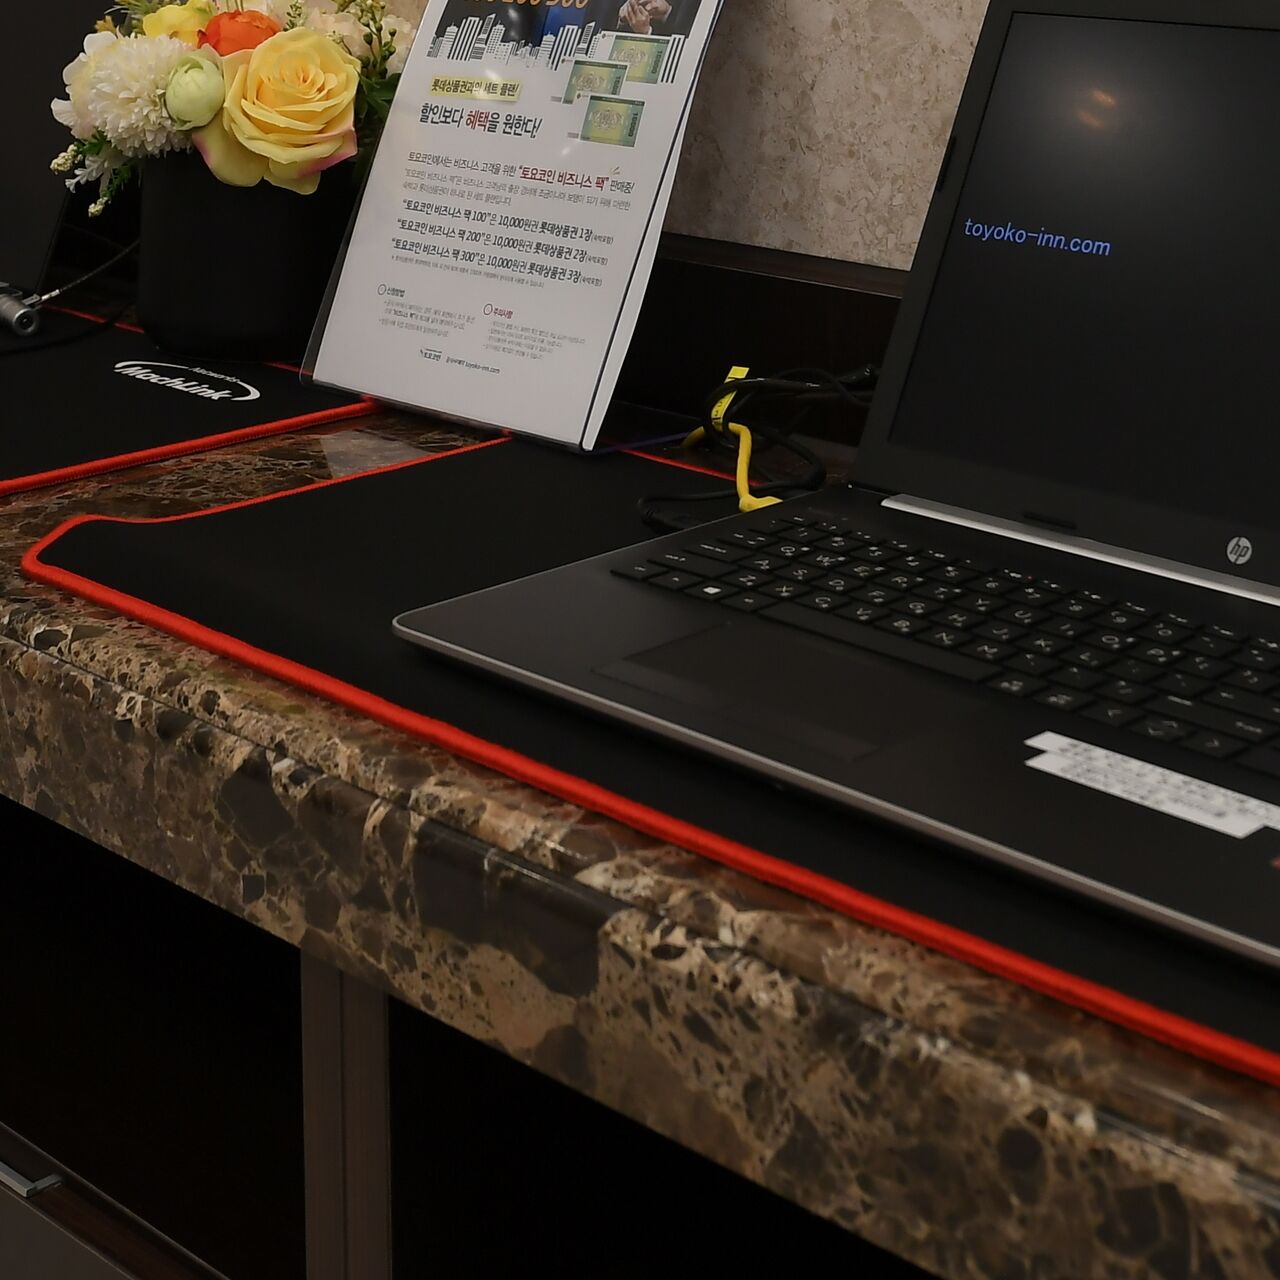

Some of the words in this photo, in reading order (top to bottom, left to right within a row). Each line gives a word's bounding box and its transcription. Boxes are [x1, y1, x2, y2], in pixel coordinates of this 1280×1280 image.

[419, 103, 464, 128] 할인보다
[465, 110, 500, 133] 혜택을
[502, 113, 543, 139] 원한다!
[408, 151, 452, 168] 토요코인에서는
[453, 158, 479, 171] 비즈니스
[480, 162, 501, 175] 고객을
[503, 165, 517, 177] 위한
[557, 171, 592, 188] 비즈니스
[434, 205, 462, 219] 비즈니스
[463, 209, 472, 222] 팩
[498, 215, 539, 233] 10,000원권
[539, 221, 579, 239] 롯데상품권
[964, 218, 1112, 257] toyoko-inn.com
[428, 224, 456, 239] 비즈니스
[458, 229, 467, 241] 팩
[492, 235, 534, 253] 10,000원권
[533, 241, 574, 260] 롯데상품권
[422, 243, 450, 258] 비즈니스
[451, 248, 460, 261] 팩
[486, 255, 527, 274] 10,000원권
[527, 262, 567, 281] 롯데상품권
[113, 366, 233, 401] MachLink
[1227, 536, 1252, 565] hp
